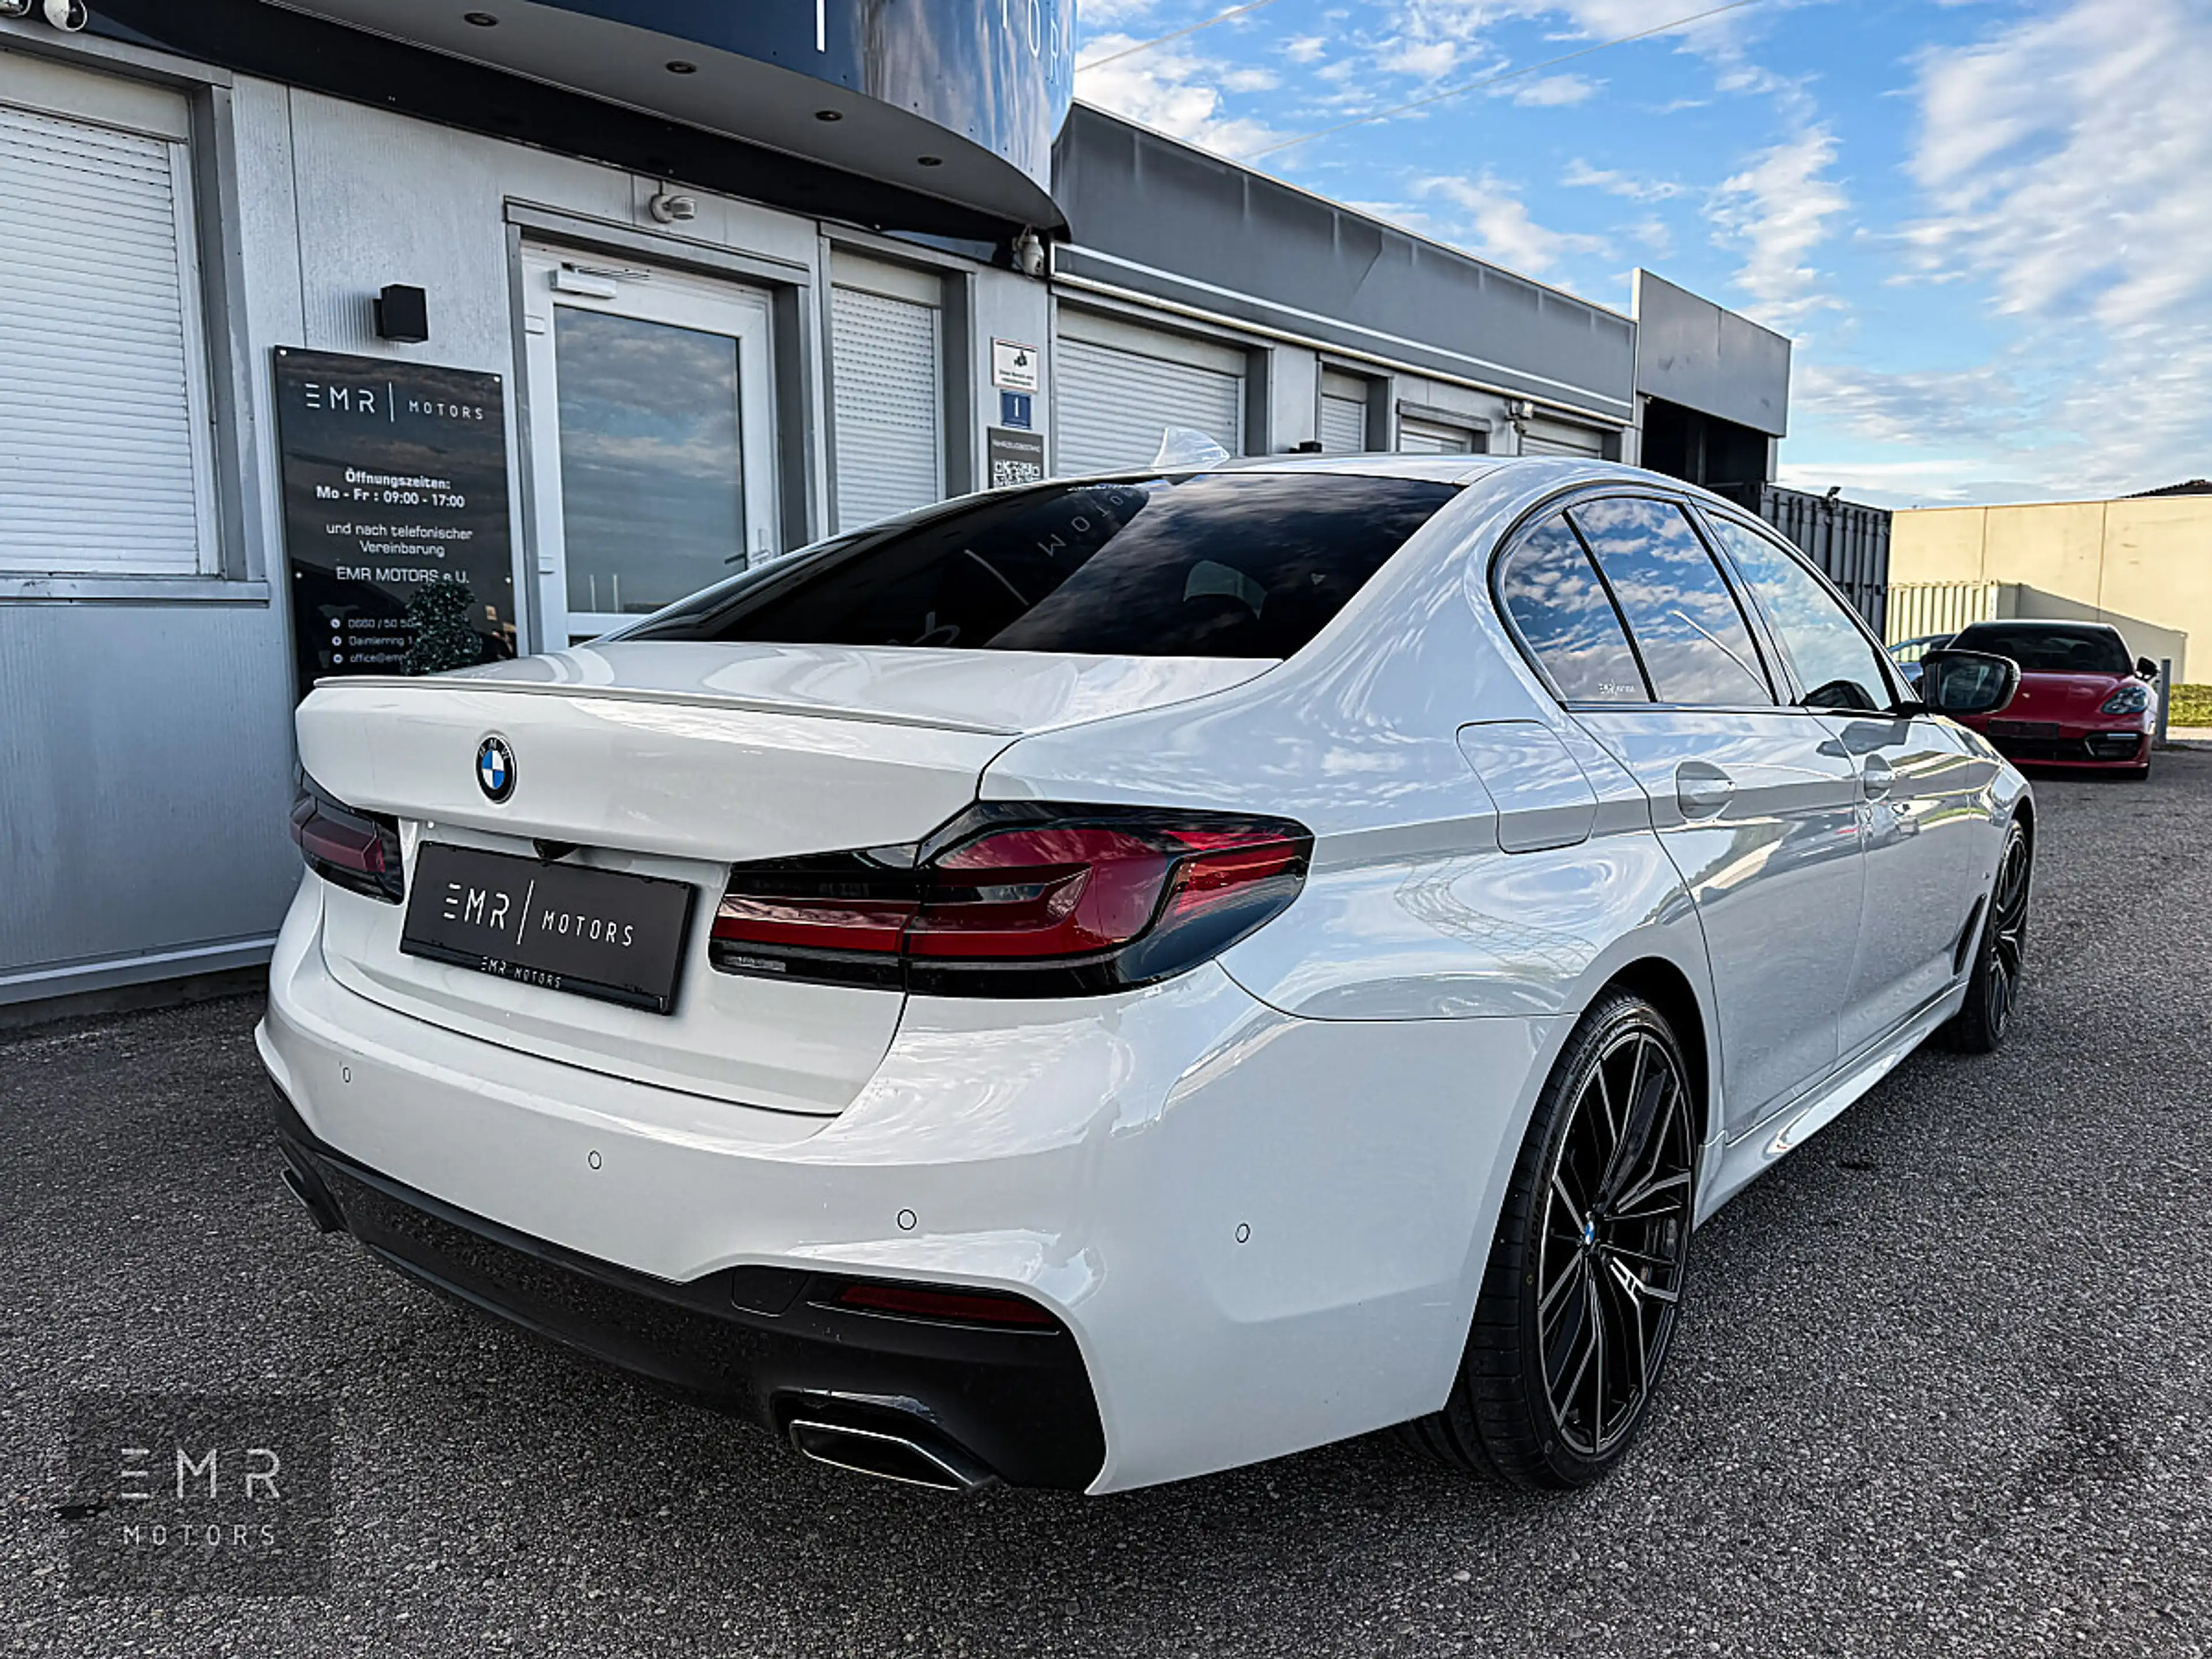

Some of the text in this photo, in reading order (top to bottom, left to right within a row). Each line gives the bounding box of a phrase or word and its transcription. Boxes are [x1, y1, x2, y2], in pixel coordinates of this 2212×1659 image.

[305, 383, 484, 421] EMR MOTORS
[345, 468, 450, 490] Öffnungszeiten:
[316, 485, 340, 499] Mo
[354, 488, 370, 501] Fr
[383, 491, 419, 505] 09:00
[432, 493, 465, 508] 17:00
[326, 523, 473, 540] und nach telefonischer
[359, 539, 446, 558] Vereinbarung
[336, 566, 372, 581] EMR
[376, 568, 438, 582] MOTORS
[443, 882, 634, 947] EMR MOTORS
[480, 956, 561, 989] EMR MOTORS
